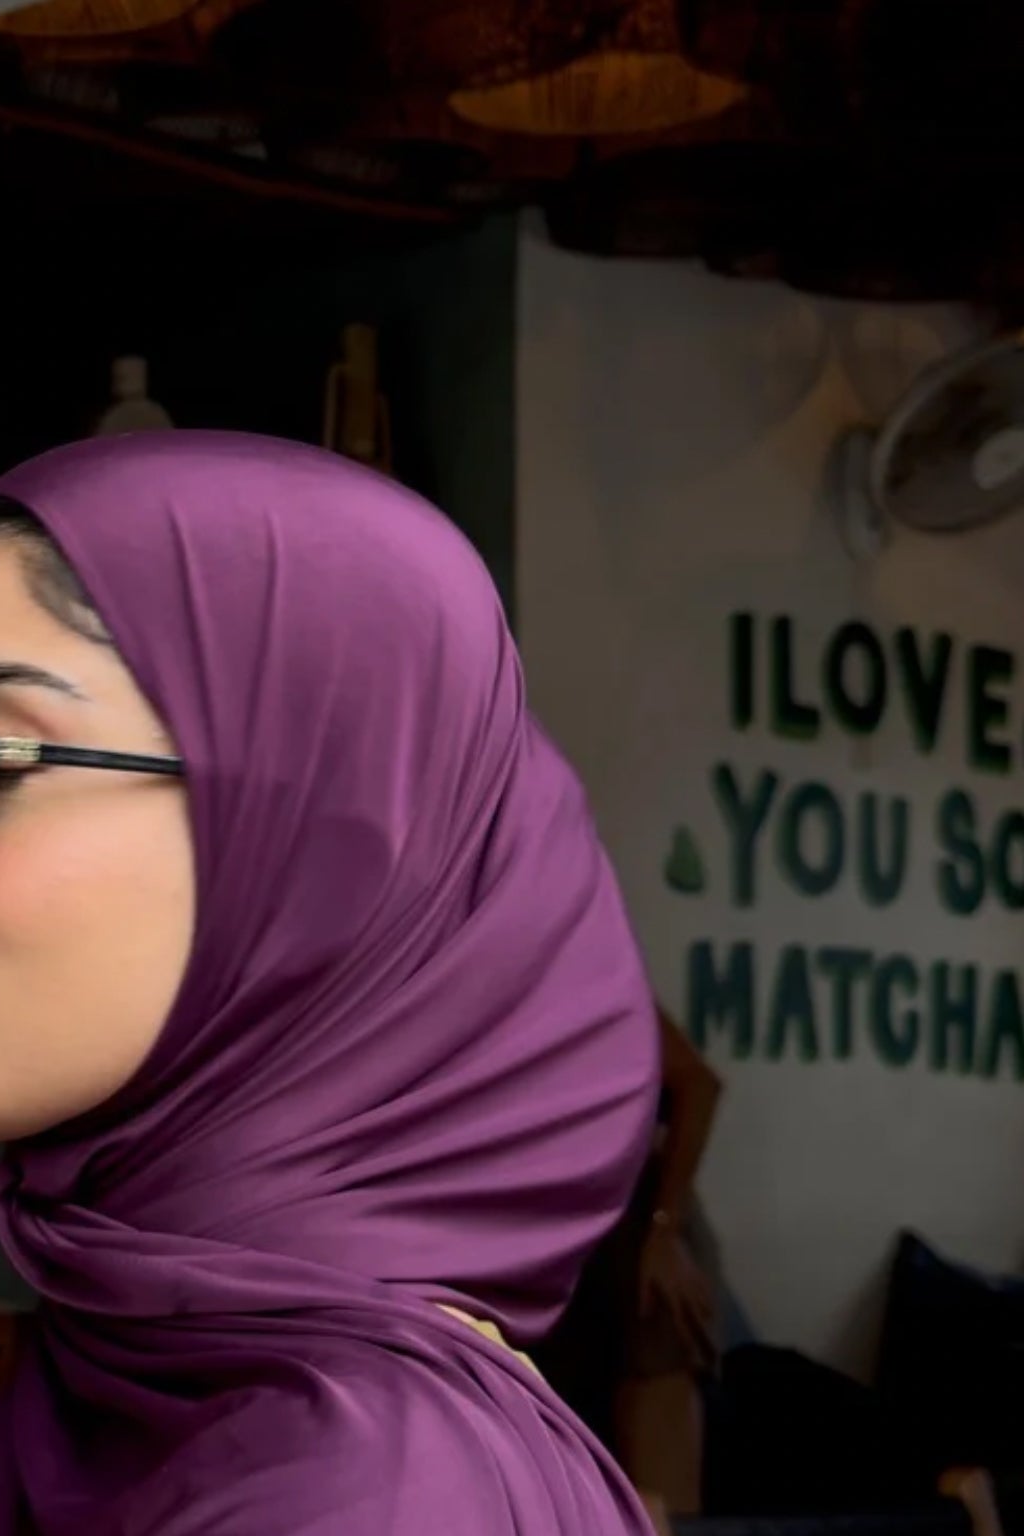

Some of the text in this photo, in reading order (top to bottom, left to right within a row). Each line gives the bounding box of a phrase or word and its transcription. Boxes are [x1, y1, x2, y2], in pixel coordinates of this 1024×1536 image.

[711, 760, 1024, 917] YOU SO
[687, 939, 1024, 1085] MATCHA
